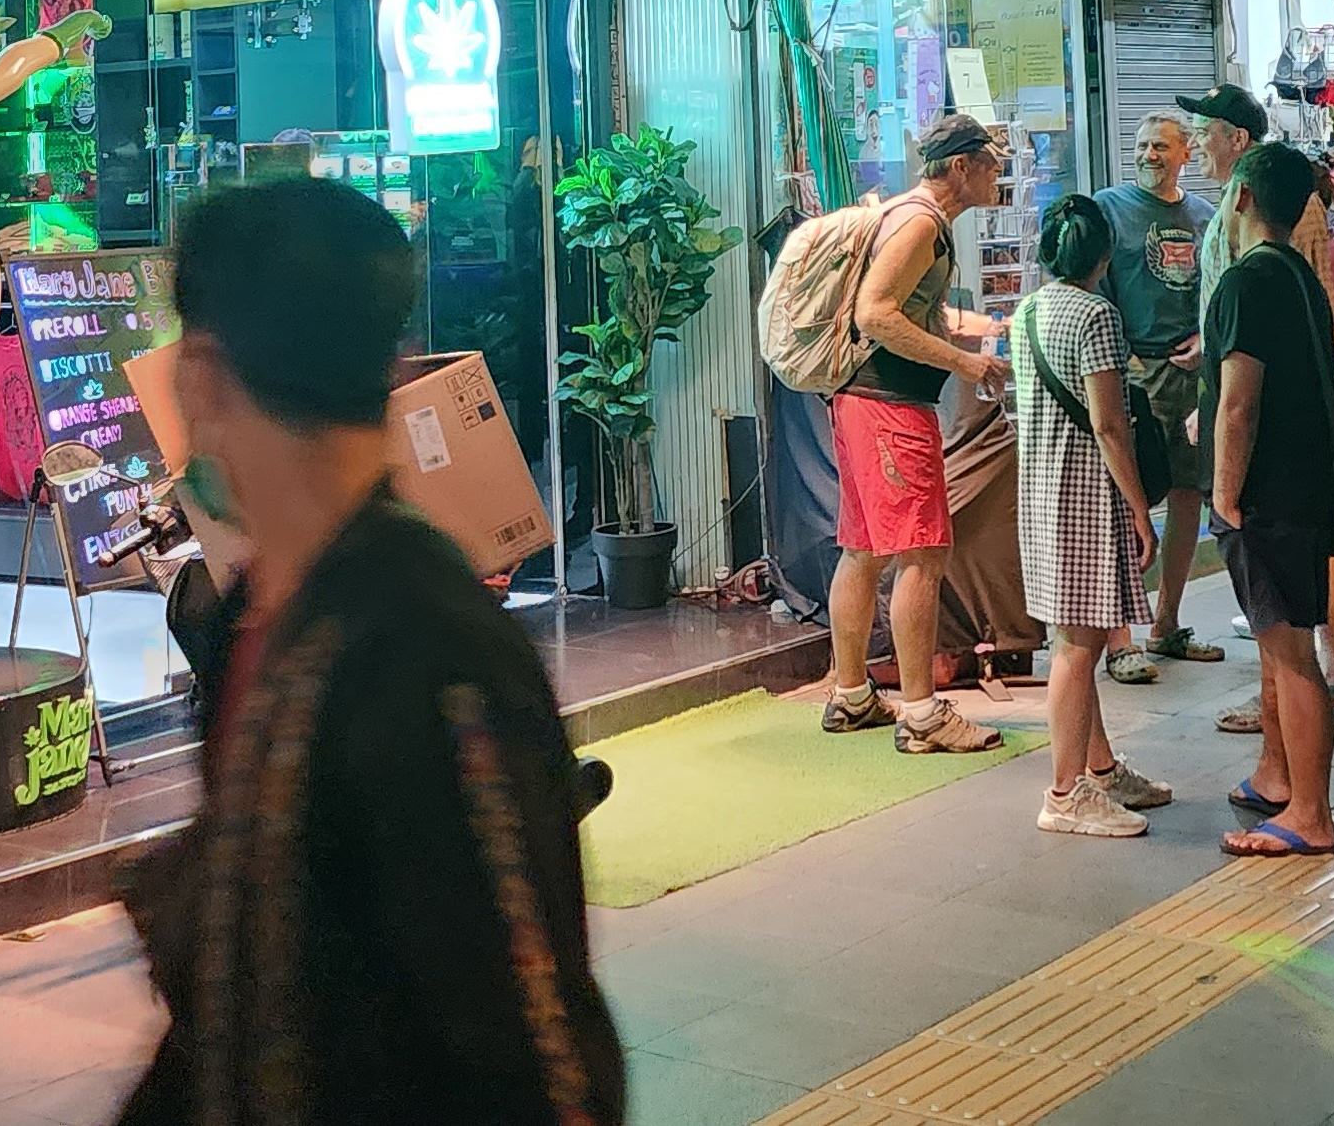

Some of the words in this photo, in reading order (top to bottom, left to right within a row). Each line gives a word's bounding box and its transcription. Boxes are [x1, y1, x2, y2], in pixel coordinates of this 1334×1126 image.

[78, 259, 138, 299] Jane
[30, 313, 108, 342] PREROLL
[48, 404, 98, 432] ORANGE
[80, 424, 122, 450] CREAM
